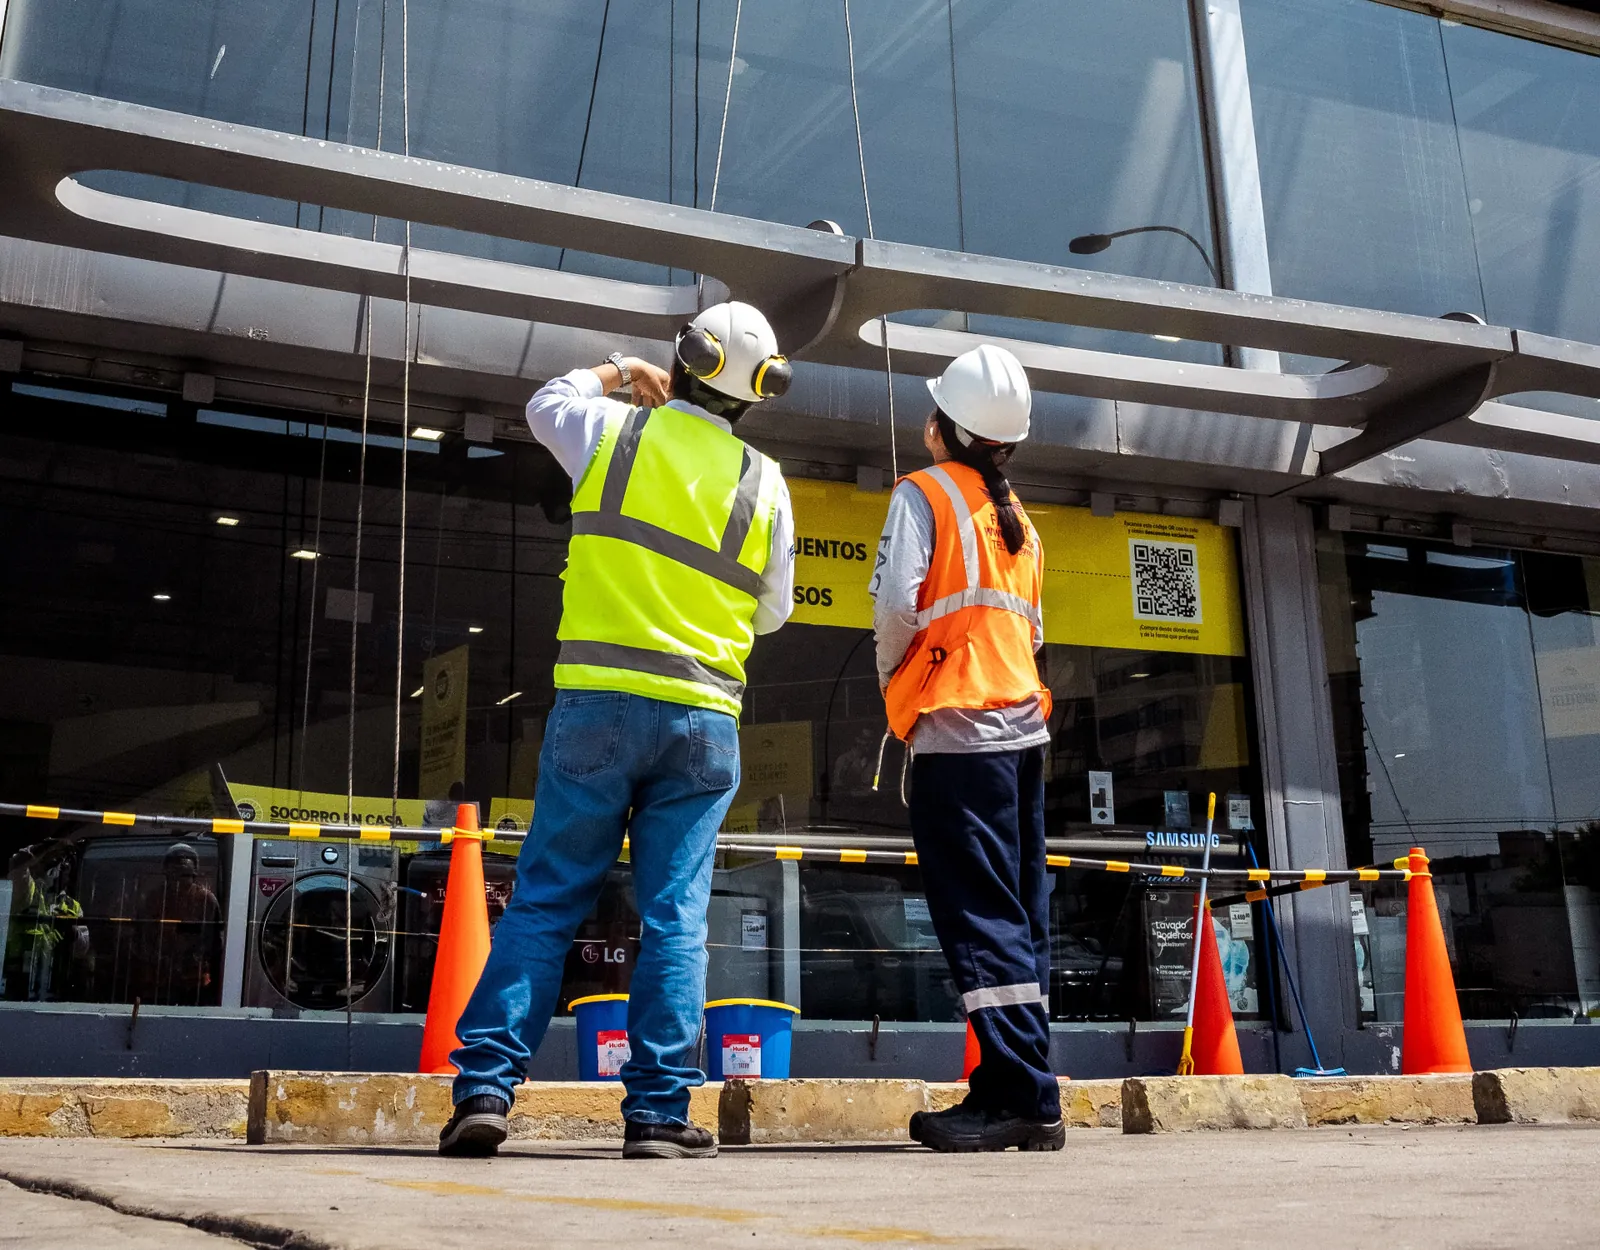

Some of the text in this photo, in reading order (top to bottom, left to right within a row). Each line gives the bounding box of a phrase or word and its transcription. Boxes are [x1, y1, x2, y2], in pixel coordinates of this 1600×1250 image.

[270, 805, 340, 823] SOCORRO
[1155, 920, 1187, 929] Lavado
[604, 947, 625, 963] LG
